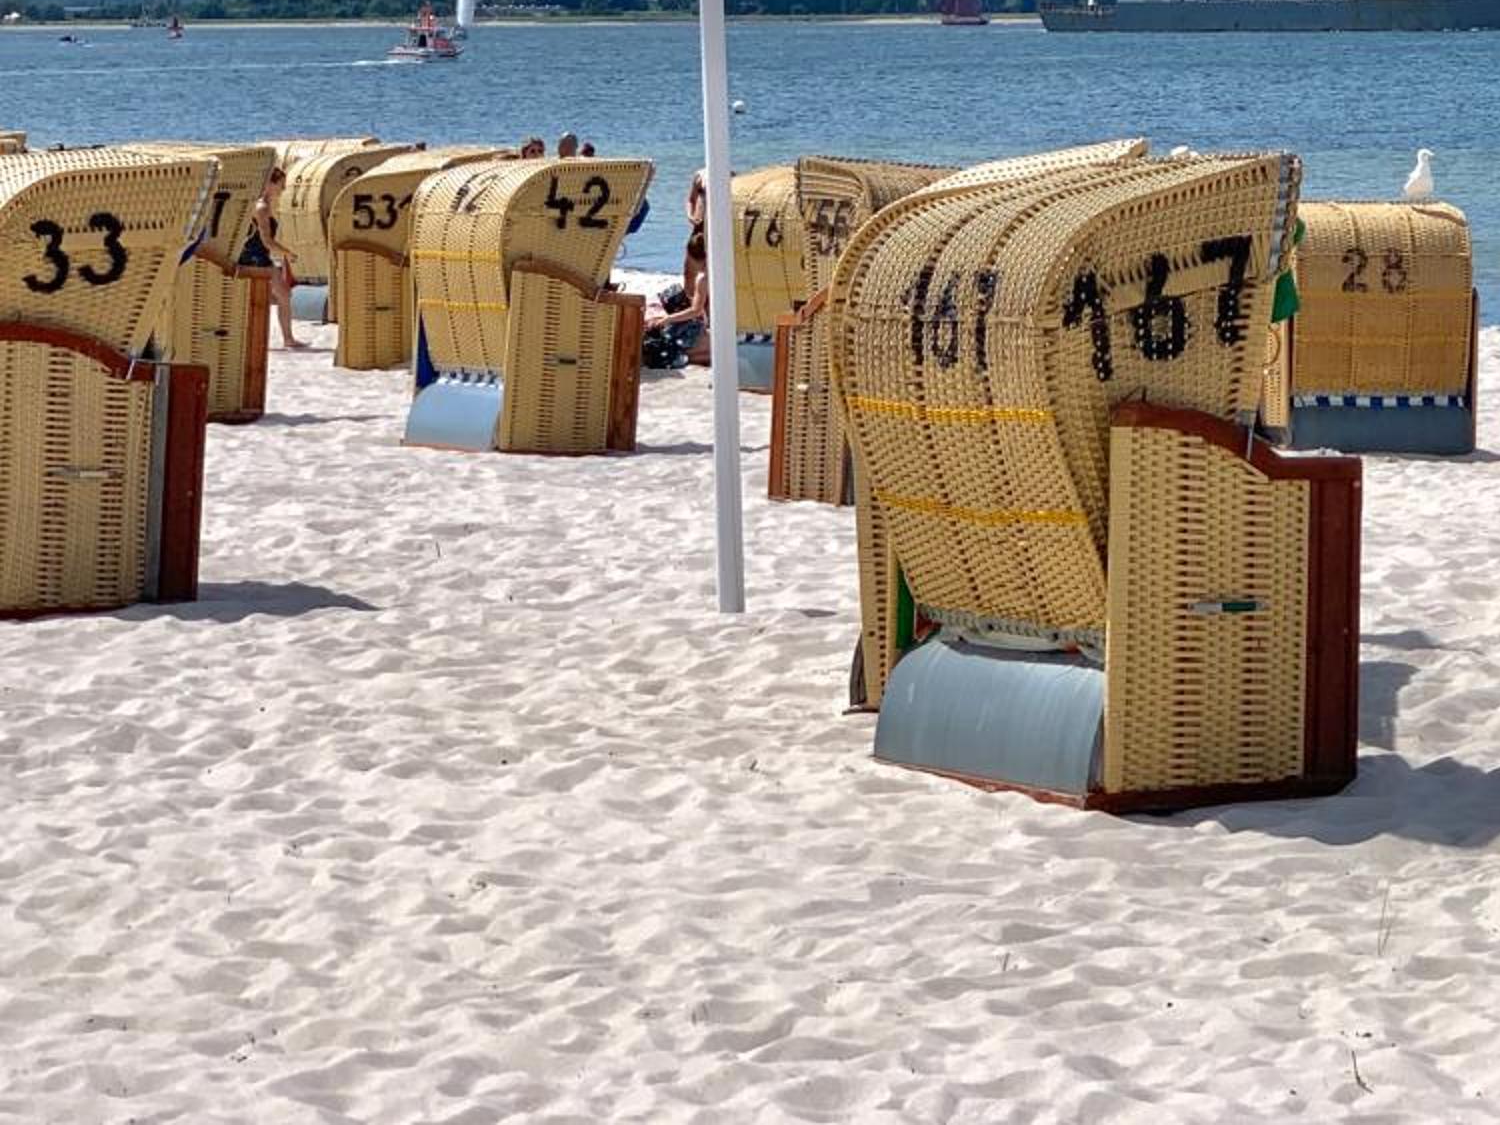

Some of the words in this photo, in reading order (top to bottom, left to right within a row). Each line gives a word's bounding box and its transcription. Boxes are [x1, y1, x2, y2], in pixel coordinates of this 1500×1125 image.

[353, 193, 413, 230] 53
[544, 175, 611, 229] 42
[23, 212, 129, 293] 33
[744, 209, 783, 248] 76
[1341, 247, 1407, 294] 28
[1062, 233, 1255, 381] 167
